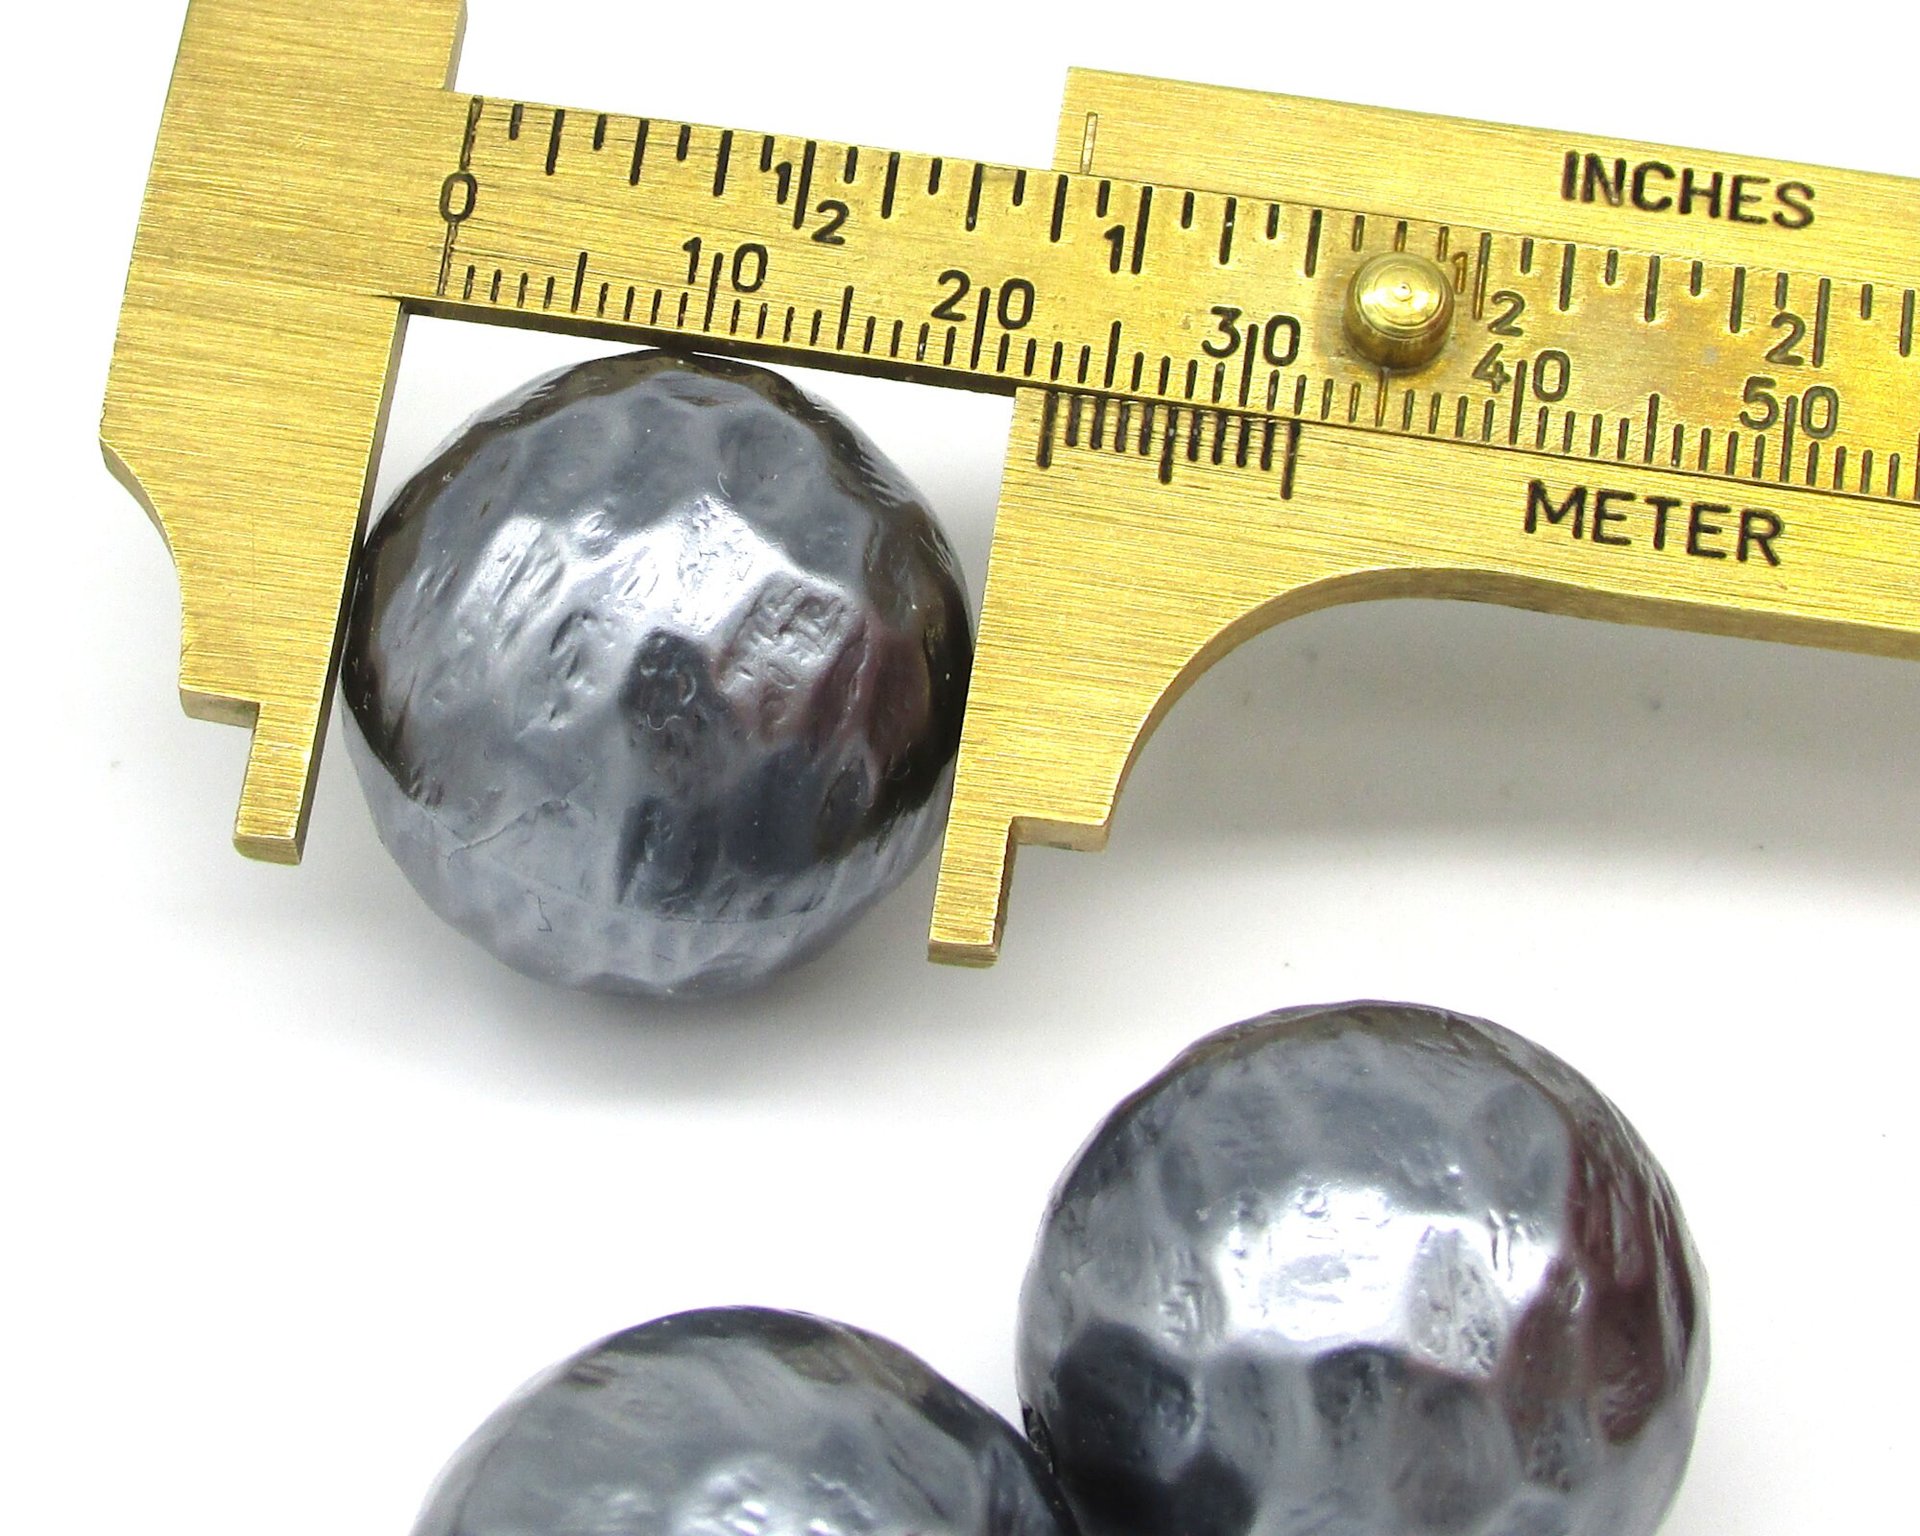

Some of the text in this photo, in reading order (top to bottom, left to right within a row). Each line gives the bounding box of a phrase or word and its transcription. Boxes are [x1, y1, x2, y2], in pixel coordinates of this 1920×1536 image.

[439, 171, 479, 223] 0
[1560, 149, 1815, 229] INCHES
[1523, 479, 1786, 567] METER
